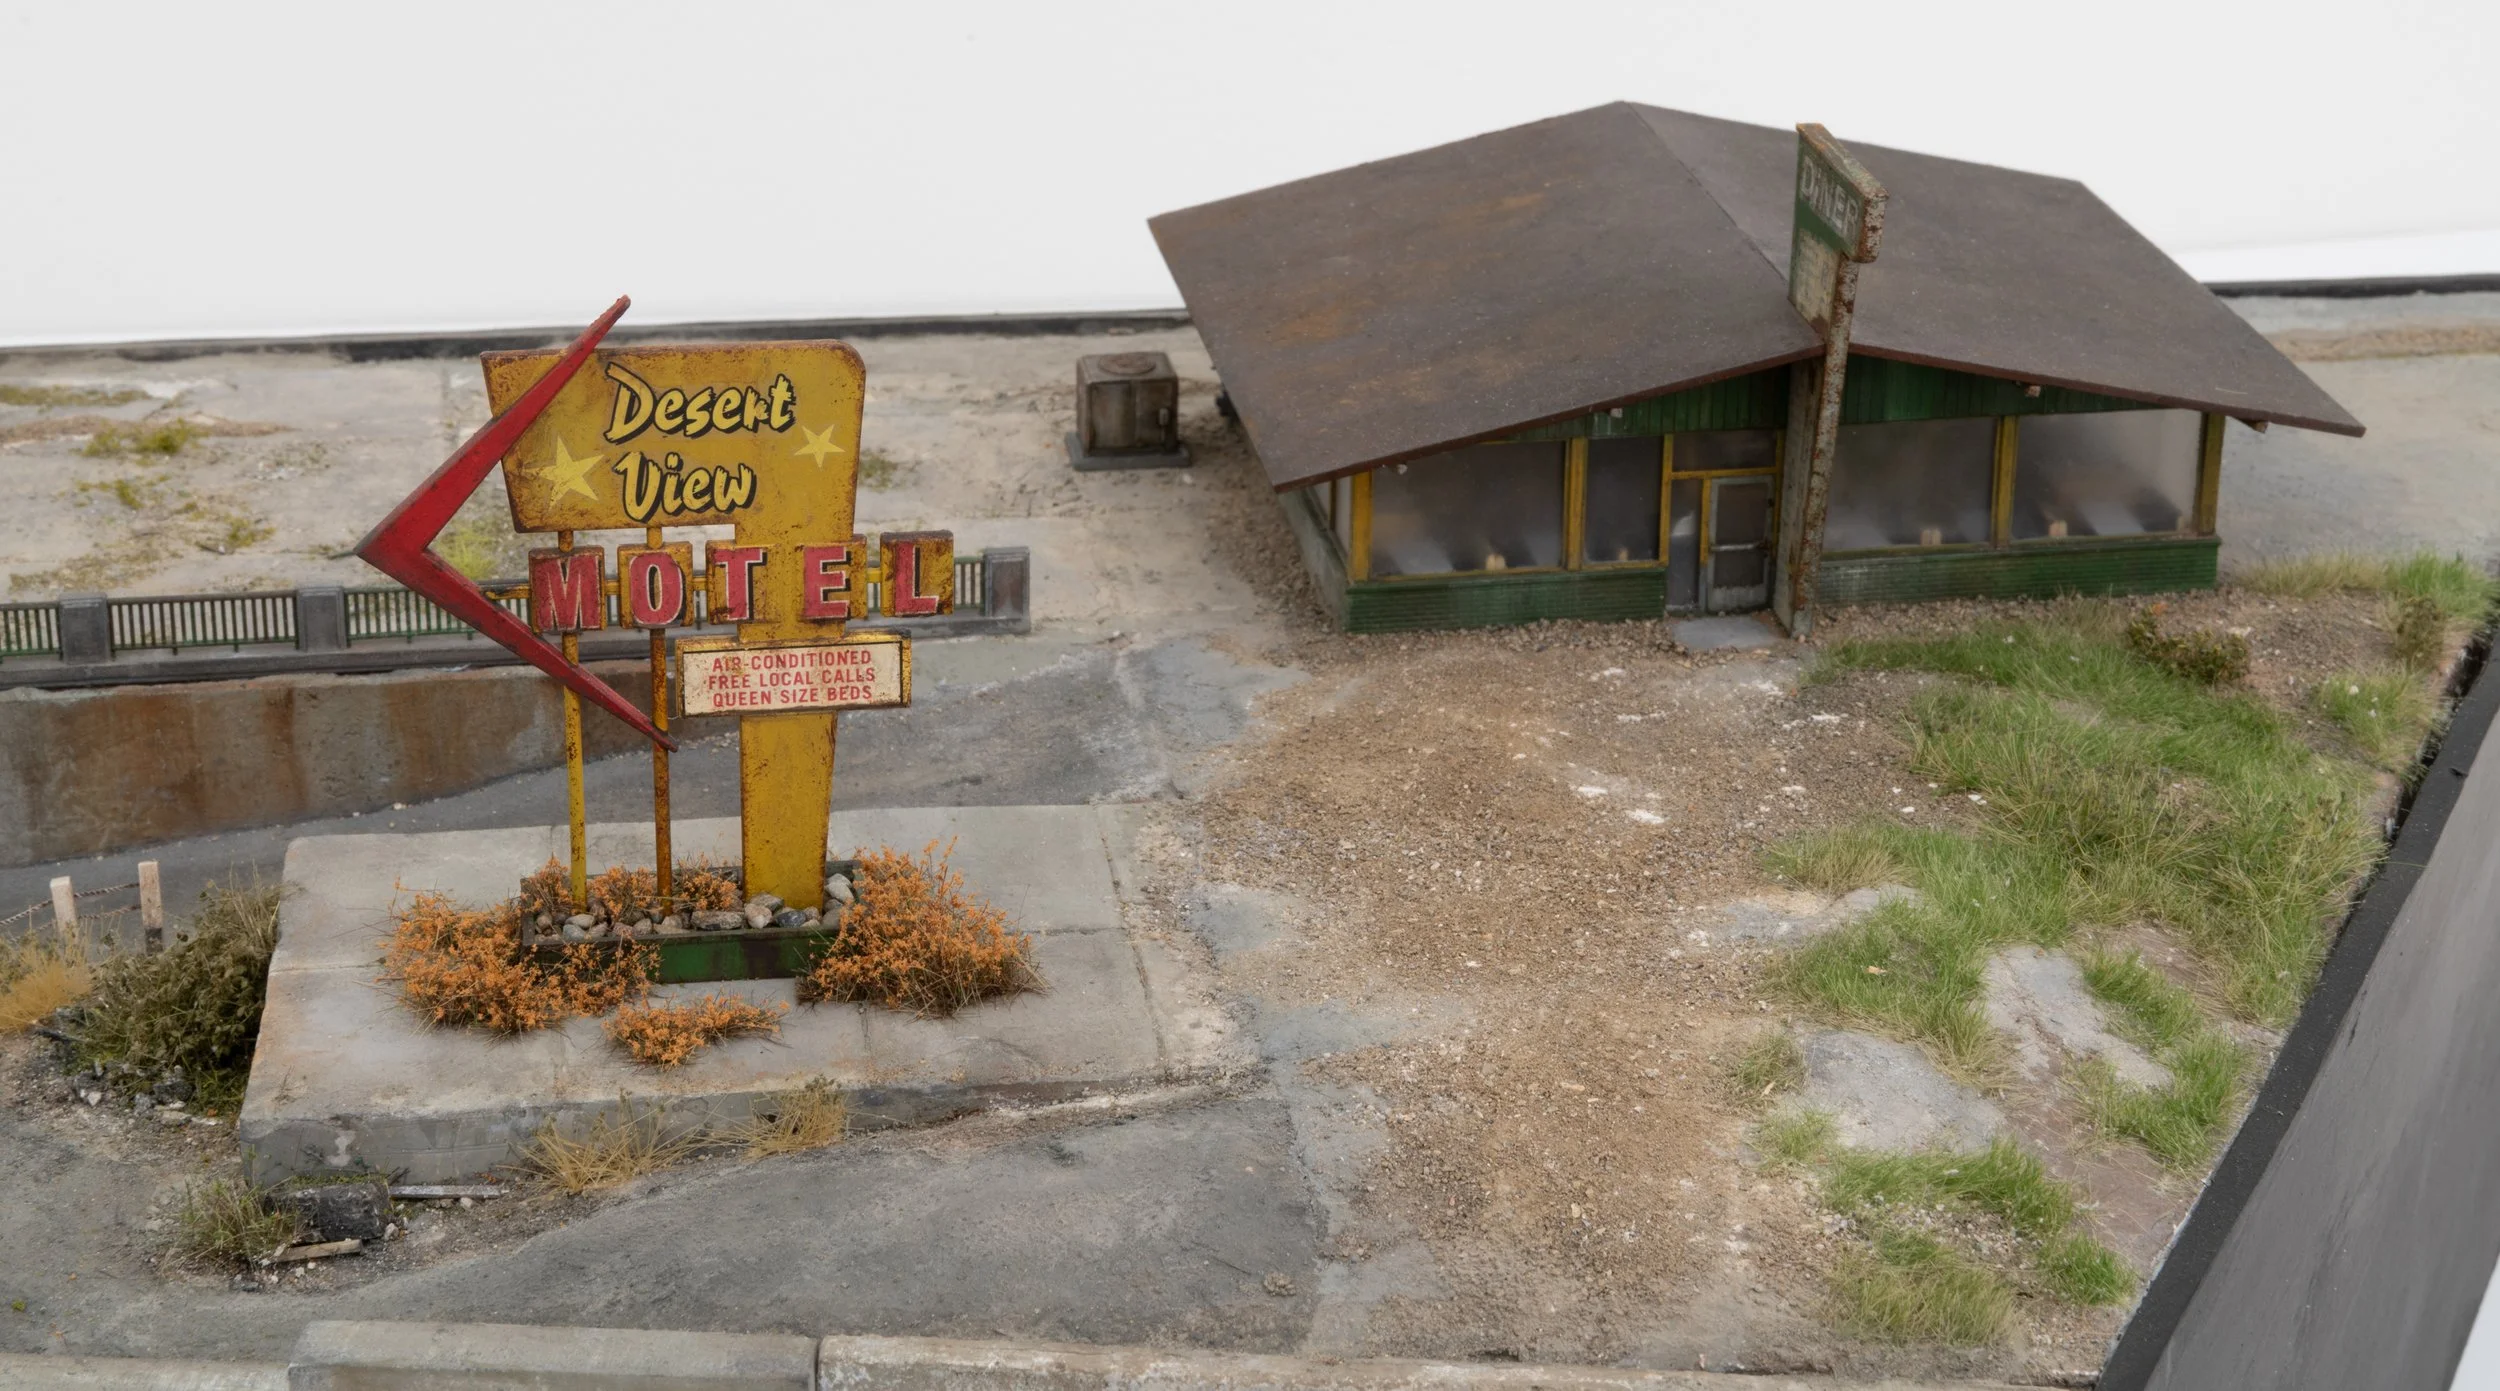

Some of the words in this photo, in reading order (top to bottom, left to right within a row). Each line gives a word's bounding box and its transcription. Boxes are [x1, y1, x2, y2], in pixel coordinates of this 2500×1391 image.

[1801, 155, 1859, 238] DINER
[603, 361, 796, 445] Desert
[612, 451, 757, 523] View
[532, 543, 939, 630] MOTEL
[708, 674, 751, 690] FREE
[759, 671, 813, 687] LOCAL
[822, 668, 875, 684] CALLS
[712, 650, 872, 672] AIR-CONDITIONED
[713, 691, 772, 708] QUEEN
[780, 688, 818, 705] SIZE
[828, 685, 872, 701] BEDS
